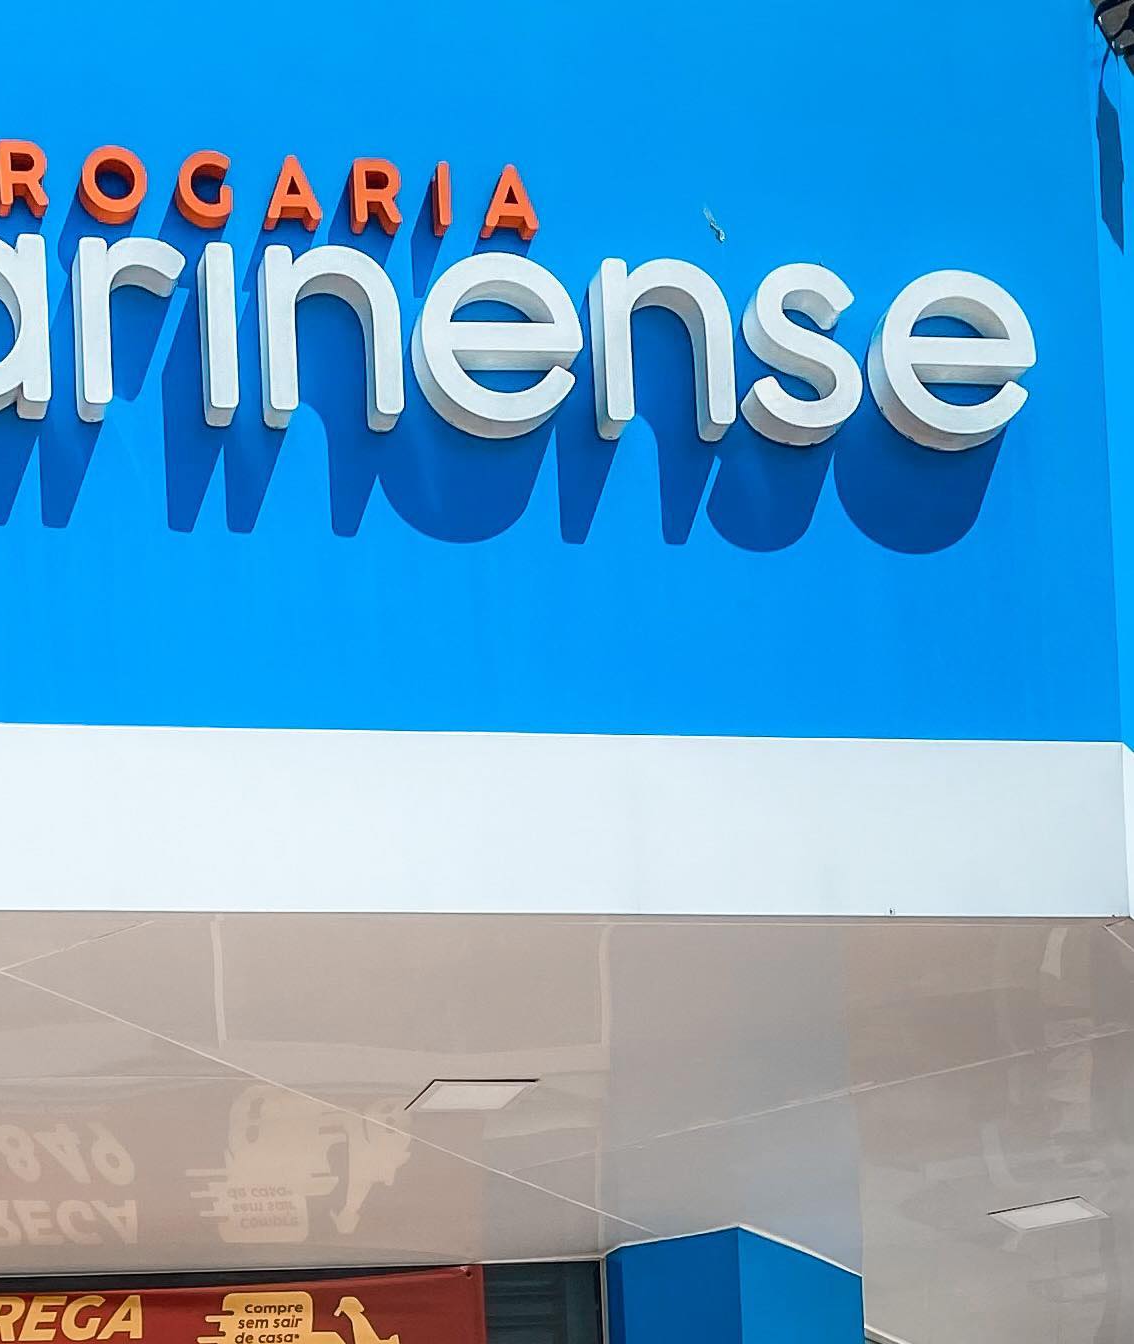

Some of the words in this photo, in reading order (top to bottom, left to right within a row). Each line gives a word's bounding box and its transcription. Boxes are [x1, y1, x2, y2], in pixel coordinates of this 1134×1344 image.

[244, 1304, 304, 1316] Compre
[238, 1318, 269, 1329] sem
[272, 1315, 303, 1328] sair
[234, 1332, 254, 1344] de
